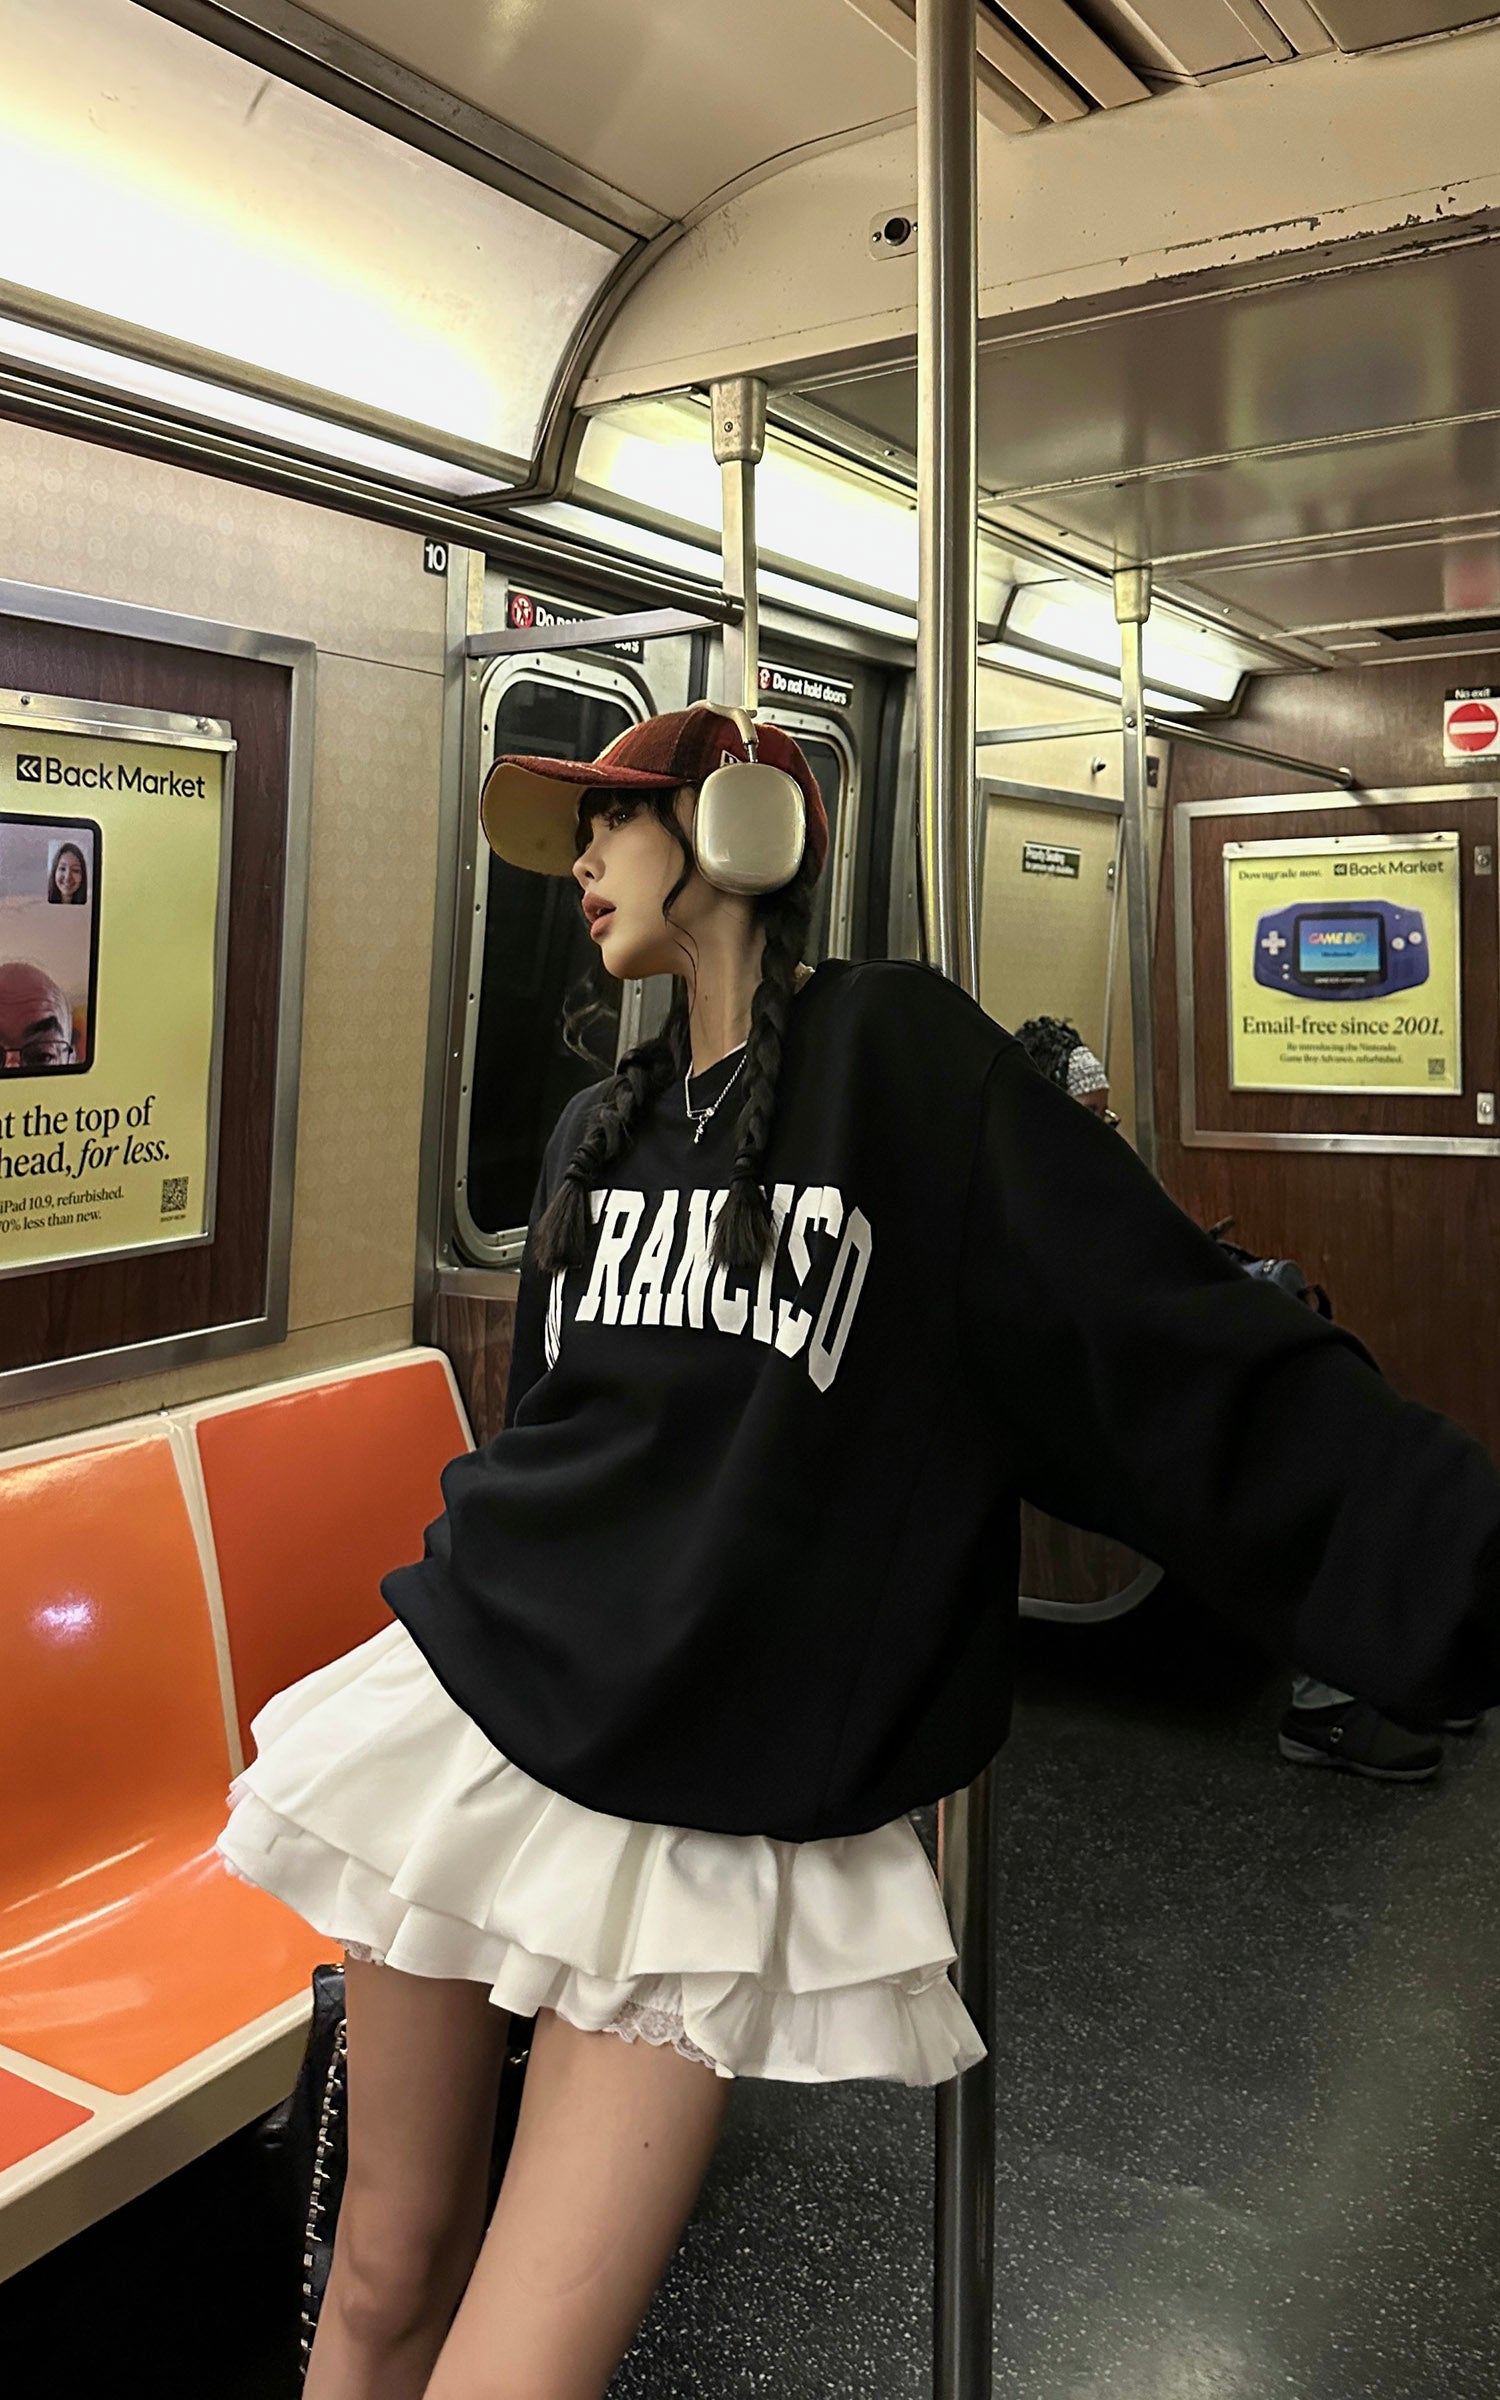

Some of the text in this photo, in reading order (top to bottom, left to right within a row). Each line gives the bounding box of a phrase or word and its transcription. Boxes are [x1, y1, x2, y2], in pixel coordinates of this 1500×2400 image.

[425, 543, 446, 571] 10
[772, 673, 847, 705] Do not hold doors
[1455, 687, 1490, 699] No exit
[46, 756, 205, 799] Back Market
[1349, 860, 1444, 876] Back Market
[1308, 932, 1343, 945] GAME
[1242, 1015, 1444, 1036] Email-free since 2001.
[0, 1095, 156, 1139] t the top of
[72, 1138, 120, 1180] for
[123, 1135, 170, 1165] less.
[0, 1186, 124, 1214] iPad 10.9, refurbished.
[0, 1210, 102, 1234] 0% less than new.
